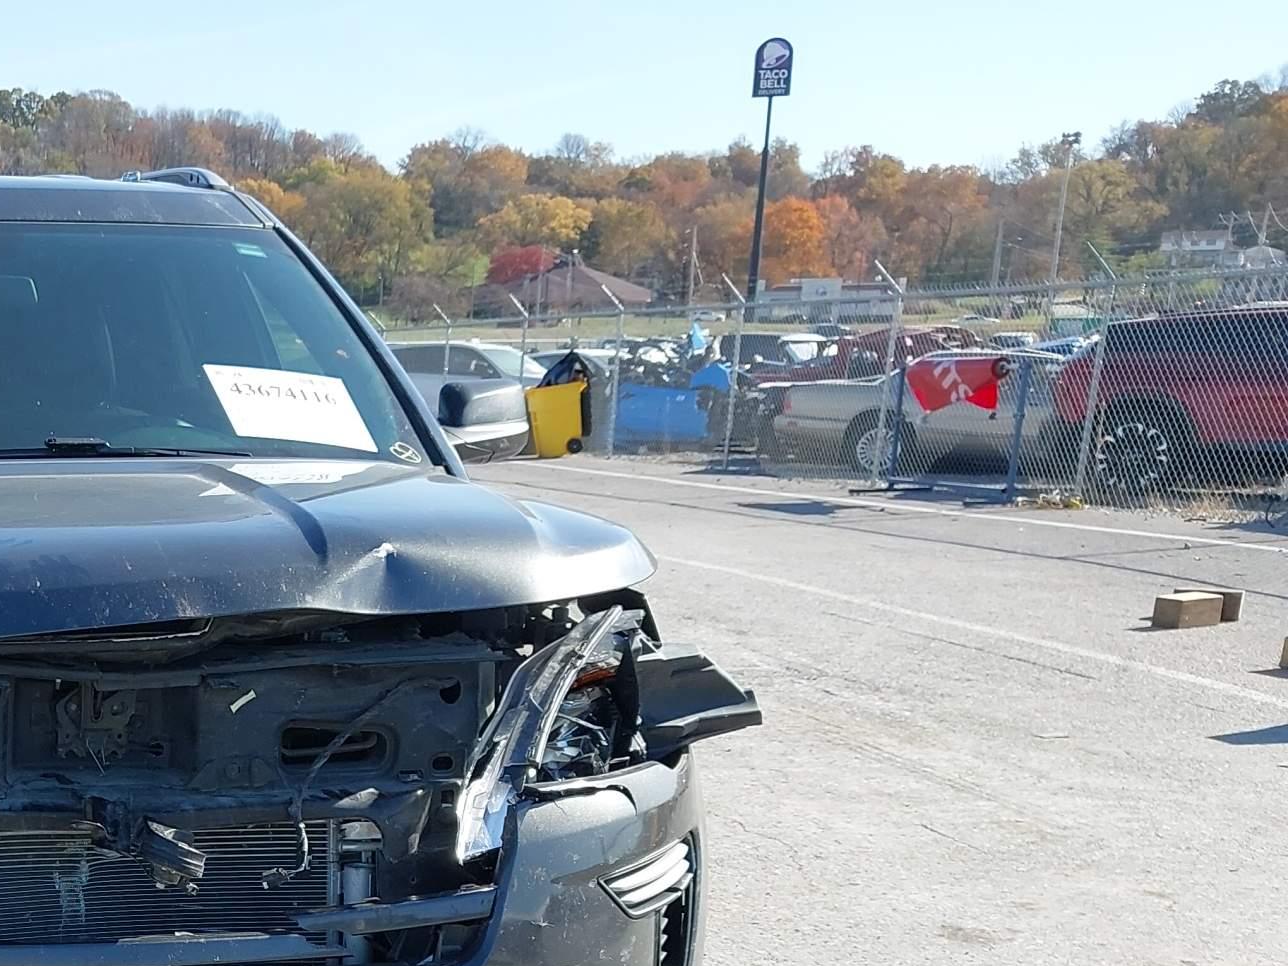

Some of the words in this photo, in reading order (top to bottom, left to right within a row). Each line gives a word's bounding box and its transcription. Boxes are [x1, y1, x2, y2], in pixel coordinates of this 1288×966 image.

[758, 69, 788, 80] TACO
[759, 79, 786, 89] BELL
[229, 382, 337, 405] 43674116
